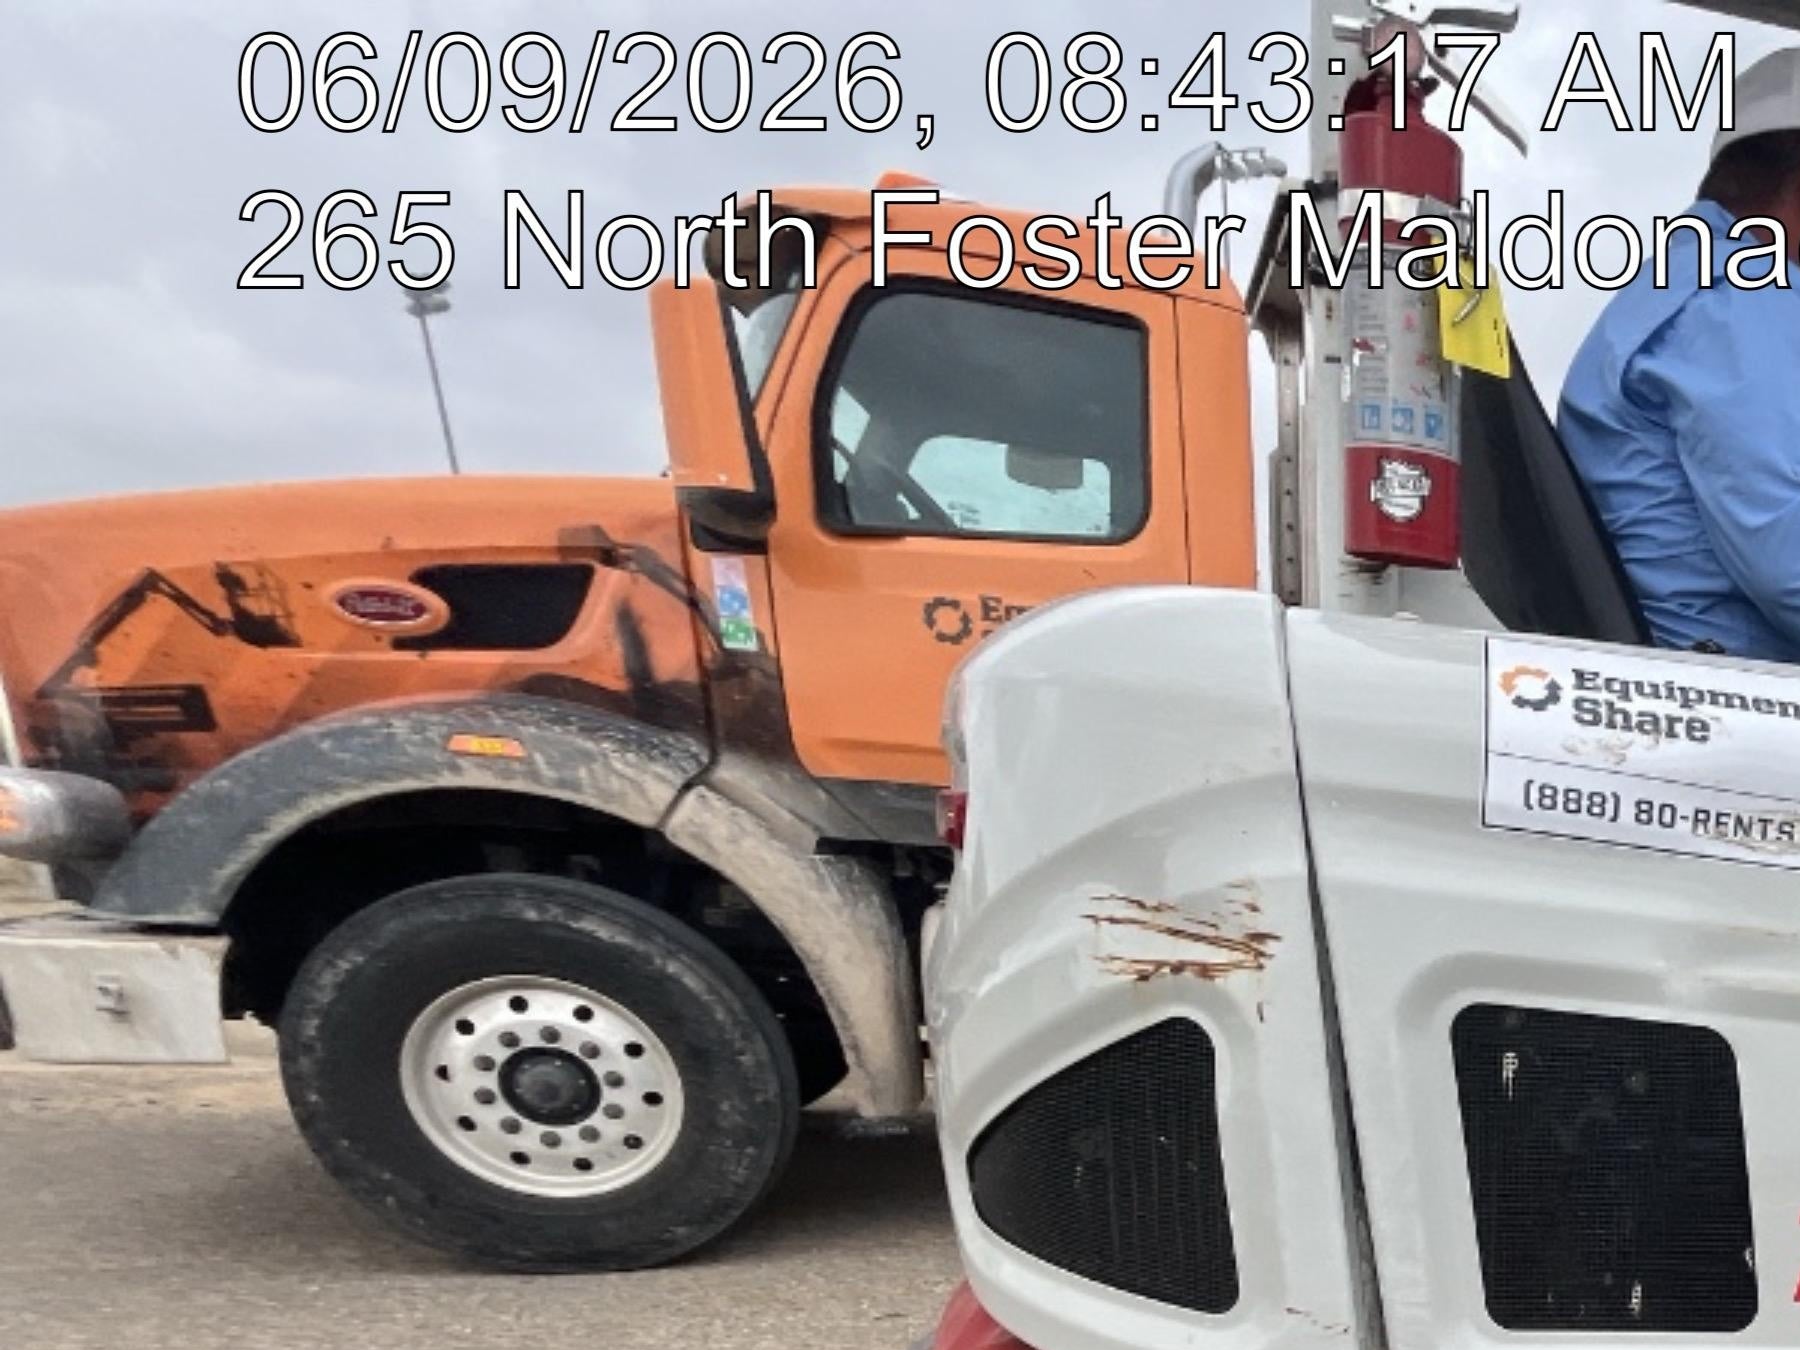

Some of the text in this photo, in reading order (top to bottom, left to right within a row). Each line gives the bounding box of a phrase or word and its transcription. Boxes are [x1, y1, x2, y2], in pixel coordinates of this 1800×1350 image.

[1571, 696, 1712, 743] Share
[1523, 779, 1797, 842] (888) 80-RENTS
